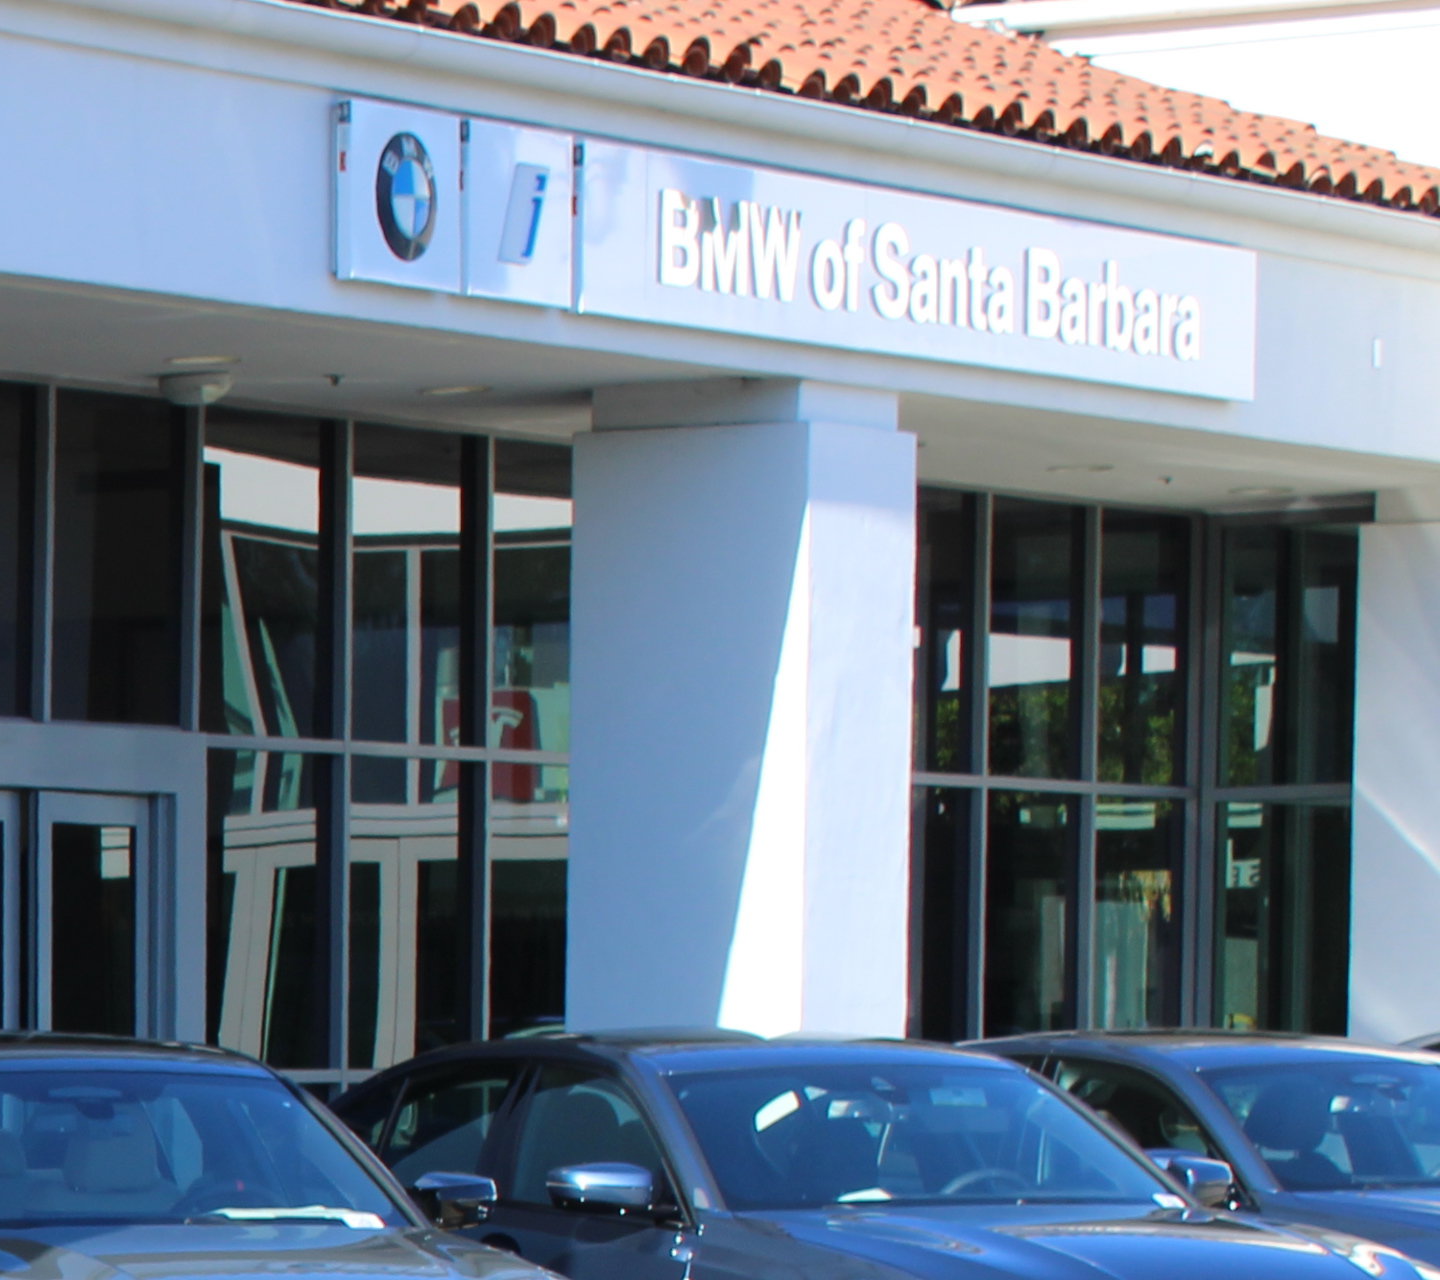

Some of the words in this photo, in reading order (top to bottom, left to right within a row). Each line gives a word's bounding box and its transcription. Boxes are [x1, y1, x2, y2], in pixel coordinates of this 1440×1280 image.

[658, 189, 801, 302] BMW
[810, 218, 866, 312] of
[870, 221, 1014, 335] Santa
[1024, 247, 1200, 361] Barbara
